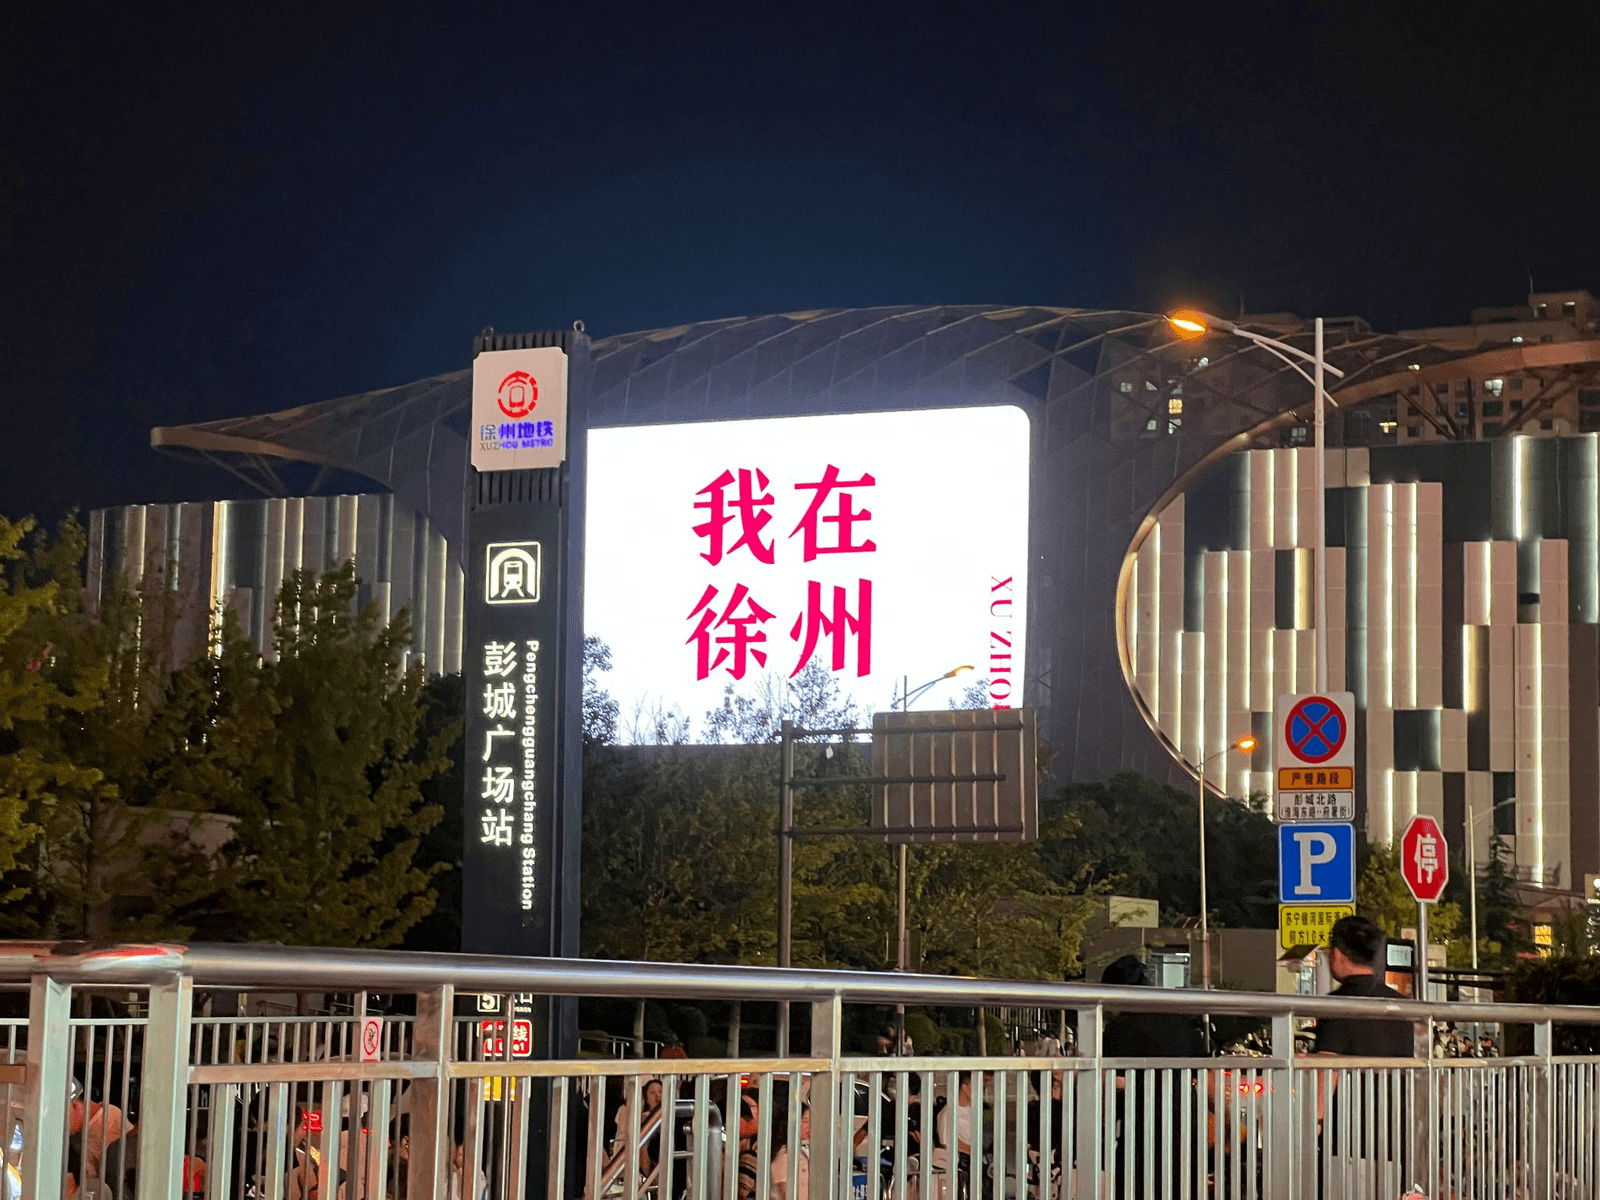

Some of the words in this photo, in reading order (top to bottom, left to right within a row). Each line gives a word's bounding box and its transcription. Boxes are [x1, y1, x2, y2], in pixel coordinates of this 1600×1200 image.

[480, 440, 518, 451] XUZHOU
[522, 438, 553, 449] METRO
[691, 463, 876, 566] 我在
[991, 576, 1013, 618] XU
[685, 577, 873, 681] 徐州
[989, 631, 1012, 710] ZHO
[481, 640, 518, 847] 彭城广场站
[520, 640, 541, 845] Pengchengguangchang
[1291, 771, 1339, 786] 严管路段
[1294, 793, 1337, 806] 彭城北路
[520, 848, 537, 910] Station
[1293, 831, 1337, 896] P
[1414, 833, 1439, 884] 停
[482, 993, 496, 1010] 5
